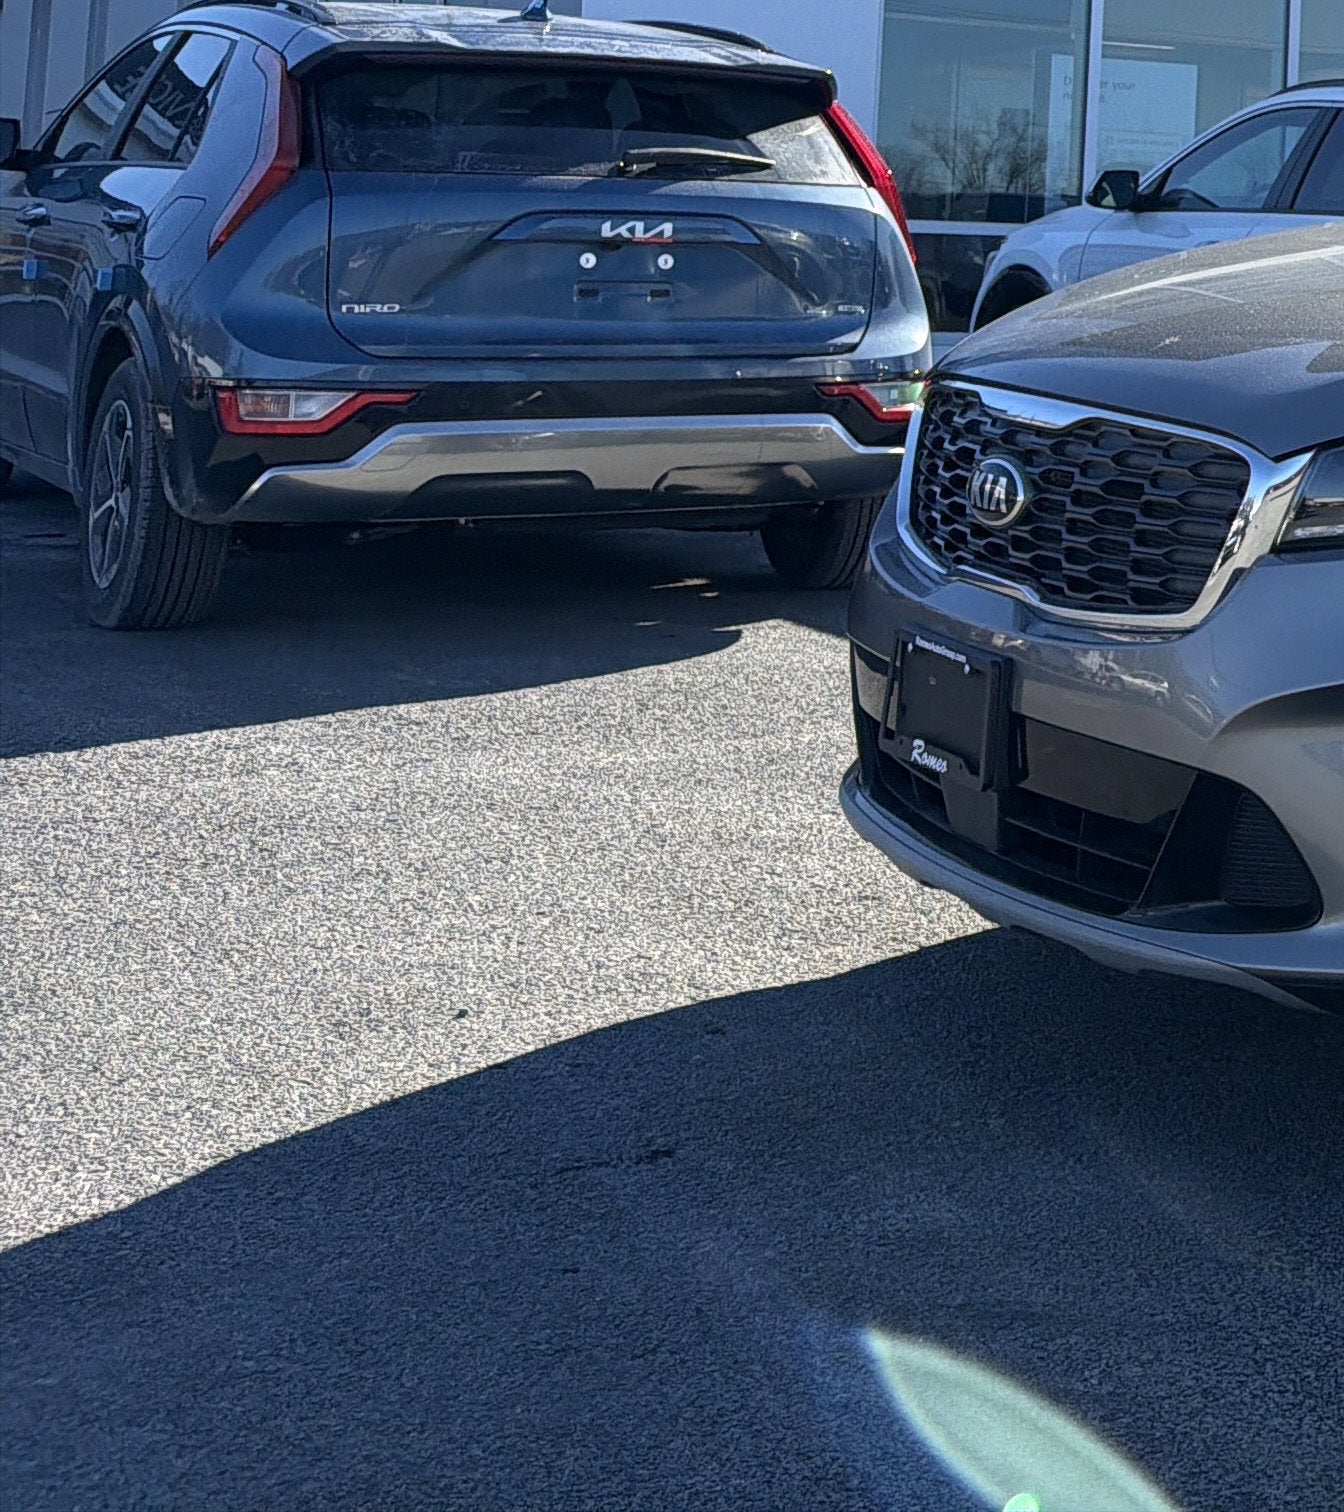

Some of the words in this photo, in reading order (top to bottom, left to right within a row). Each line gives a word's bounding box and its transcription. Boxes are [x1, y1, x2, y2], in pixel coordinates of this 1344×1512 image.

[601, 220, 674, 239] KIA
[341, 303, 401, 313] NIRO
[970, 470, 1008, 513] KIA
[911, 738, 947, 773] Romeo
